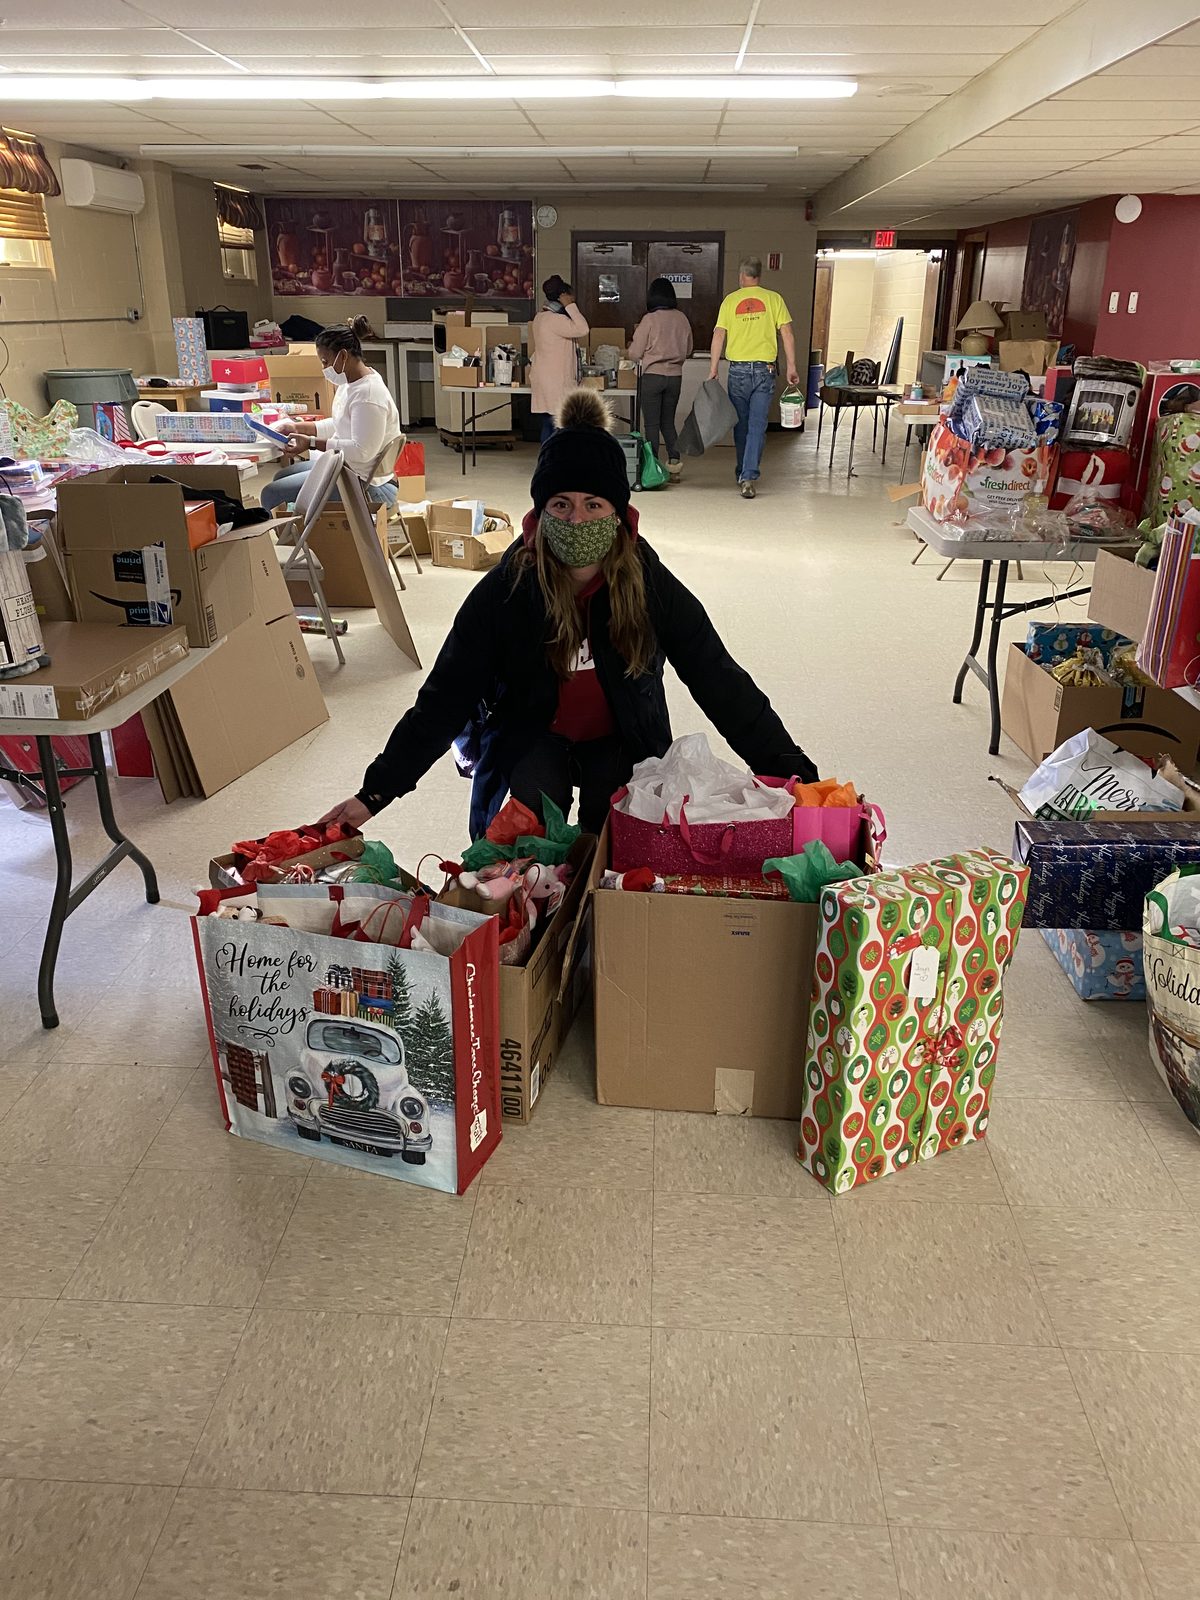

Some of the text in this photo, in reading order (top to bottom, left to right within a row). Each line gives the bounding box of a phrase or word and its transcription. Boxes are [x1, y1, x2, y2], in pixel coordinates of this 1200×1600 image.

[875, 231, 896, 248] EXIT
[1007, 381, 1023, 391] Joy
[984, 475, 1031, 491] freshdirect
[116, 556, 142, 566] prime
[129, 606, 150, 616] prim
[1080, 758, 1147, 811] Merr
[215, 942, 318, 979] Home for
[250, 969, 291, 996] the
[465, 963, 477, 1043] Christmas
[229, 994, 311, 1035] holidays
[470, 1036, 481, 1073] Tree
[343, 1140, 379, 1155] SANTA
